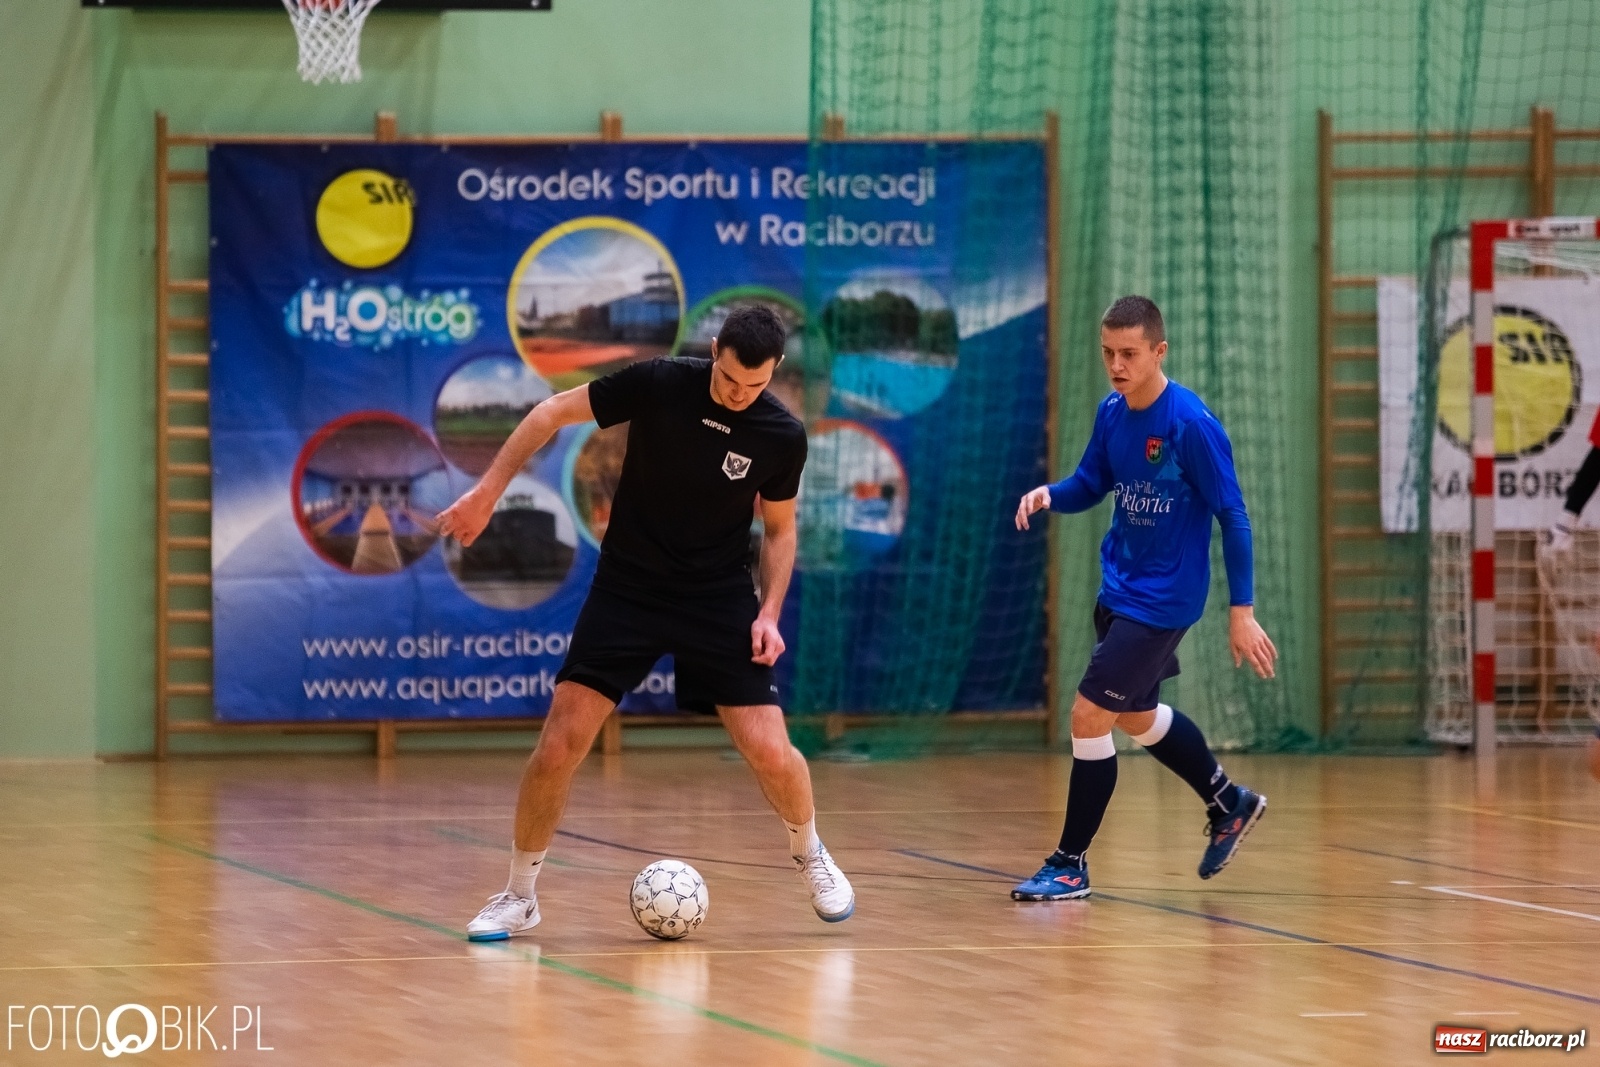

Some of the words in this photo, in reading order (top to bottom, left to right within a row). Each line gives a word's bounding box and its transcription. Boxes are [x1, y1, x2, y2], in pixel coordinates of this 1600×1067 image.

[457, 168, 614, 201] Ośrodek
[624, 166, 739, 205] Sportu
[749, 166, 760, 199] i
[771, 166, 937, 206] Rekreacji
[714, 218, 750, 244] w
[760, 213, 936, 247] Raciborzu
